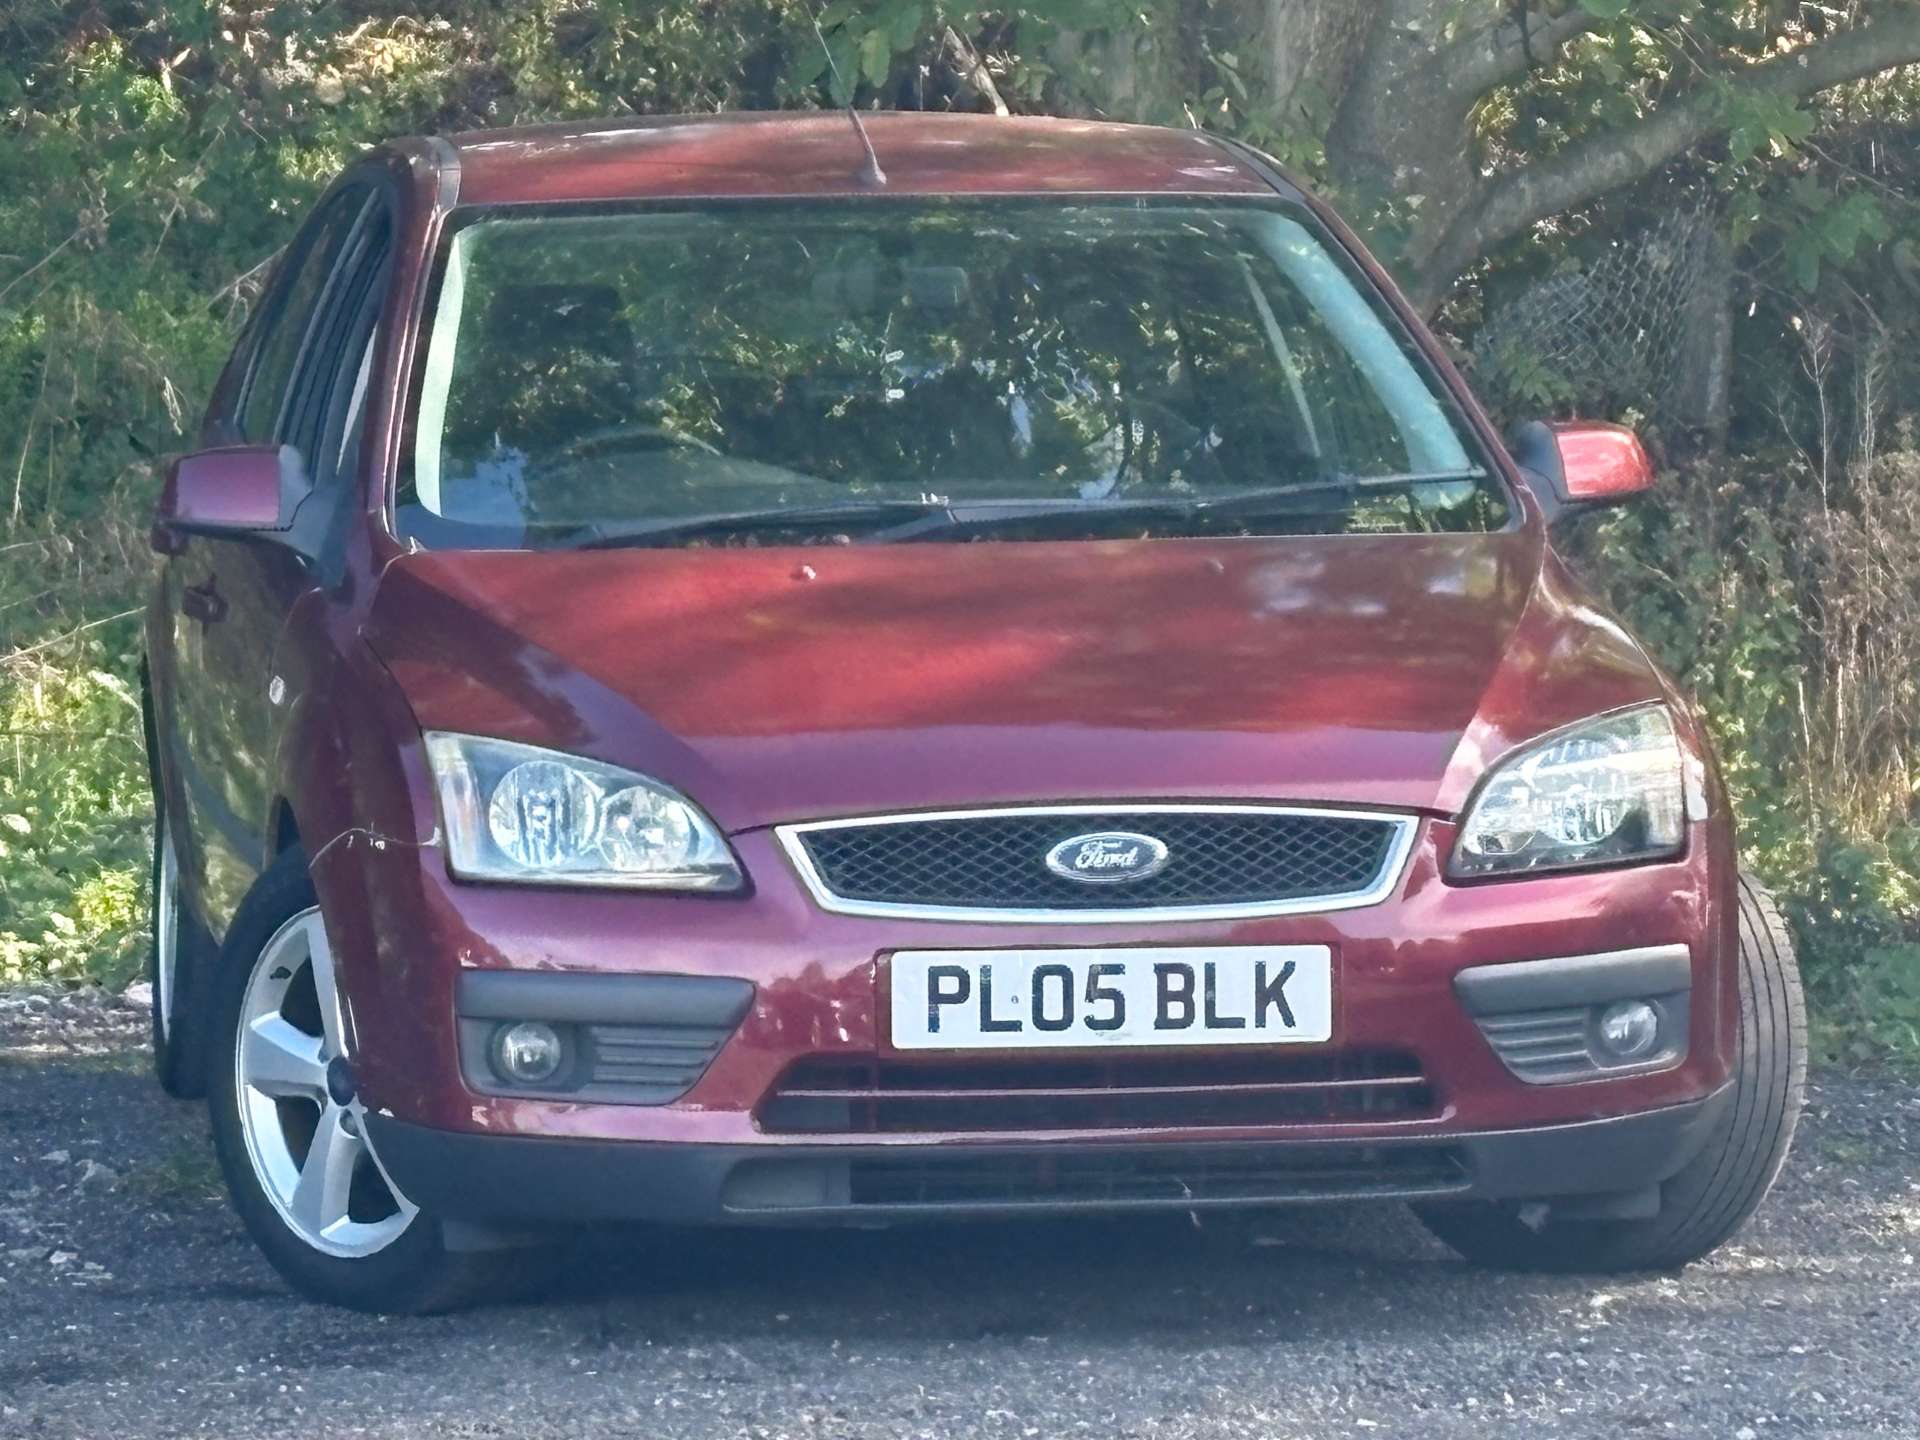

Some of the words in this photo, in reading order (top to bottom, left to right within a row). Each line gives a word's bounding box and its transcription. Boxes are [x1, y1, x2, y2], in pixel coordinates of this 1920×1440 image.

[1074, 841, 1138, 869] Ford
[927, 963, 1126, 1033] PL05
[1153, 960, 1297, 1030] BLK
